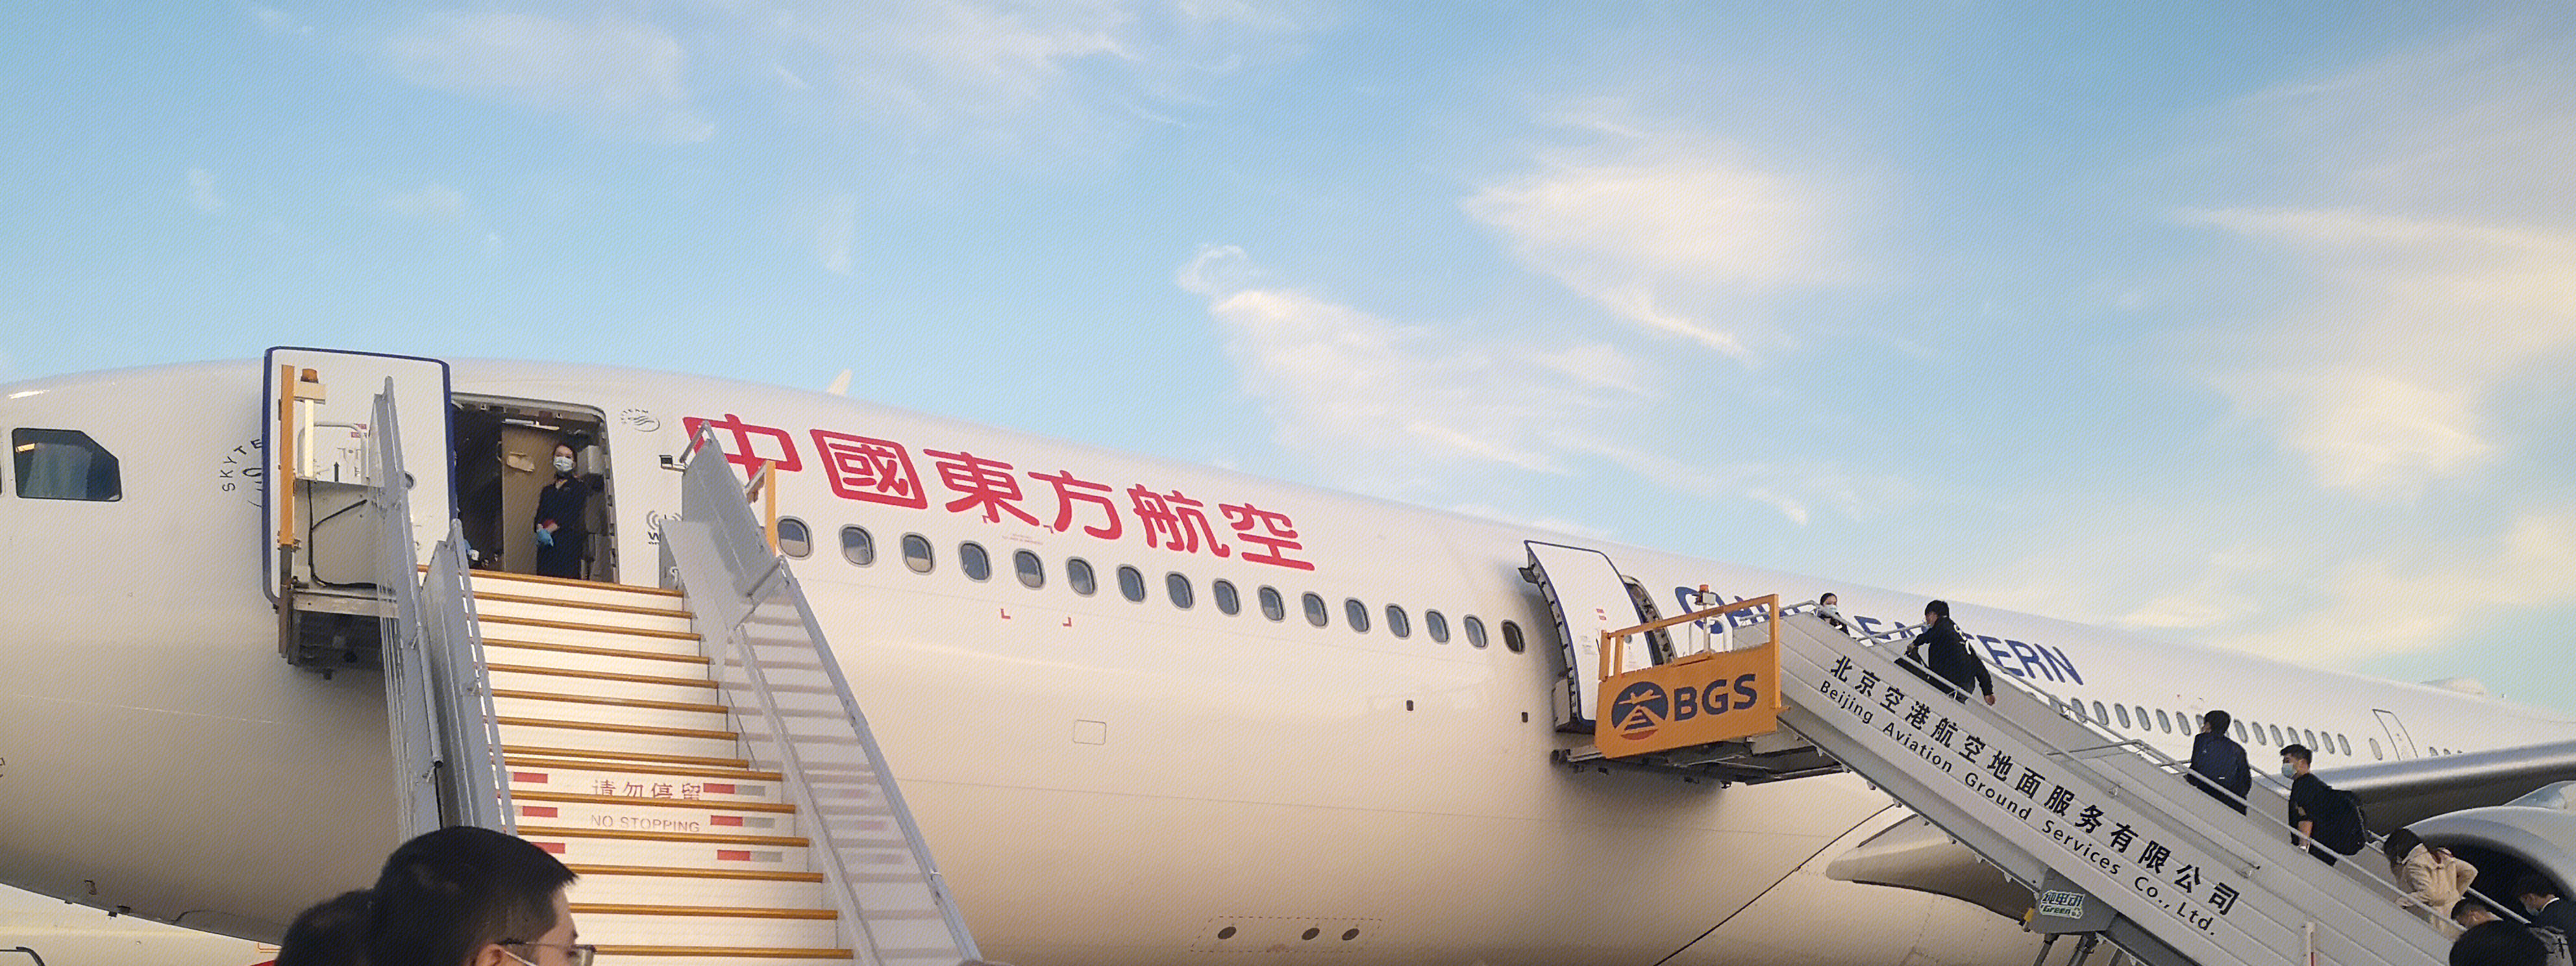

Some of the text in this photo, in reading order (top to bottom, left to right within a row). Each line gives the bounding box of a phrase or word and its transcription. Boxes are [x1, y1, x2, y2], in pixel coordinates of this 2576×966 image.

[219, 439, 262, 492] SKYTE
[683, 414, 1315, 571] 中國東方航空
[1674, 673, 1758, 721] BGS
[591, 779, 701, 800] 请勿停留
[1820, 680, 1874, 724] Beijing
[1883, 722, 1953, 773] Aviation
[1964, 772, 2032, 820] Ground
[2042, 820, 2121, 874] Services
[1830, 655, 2240, 915] 北京空港航空地面服务有限公司
[591, 814, 700, 833] NO STOPPING
[2042, 904, 2071, 914] Green
